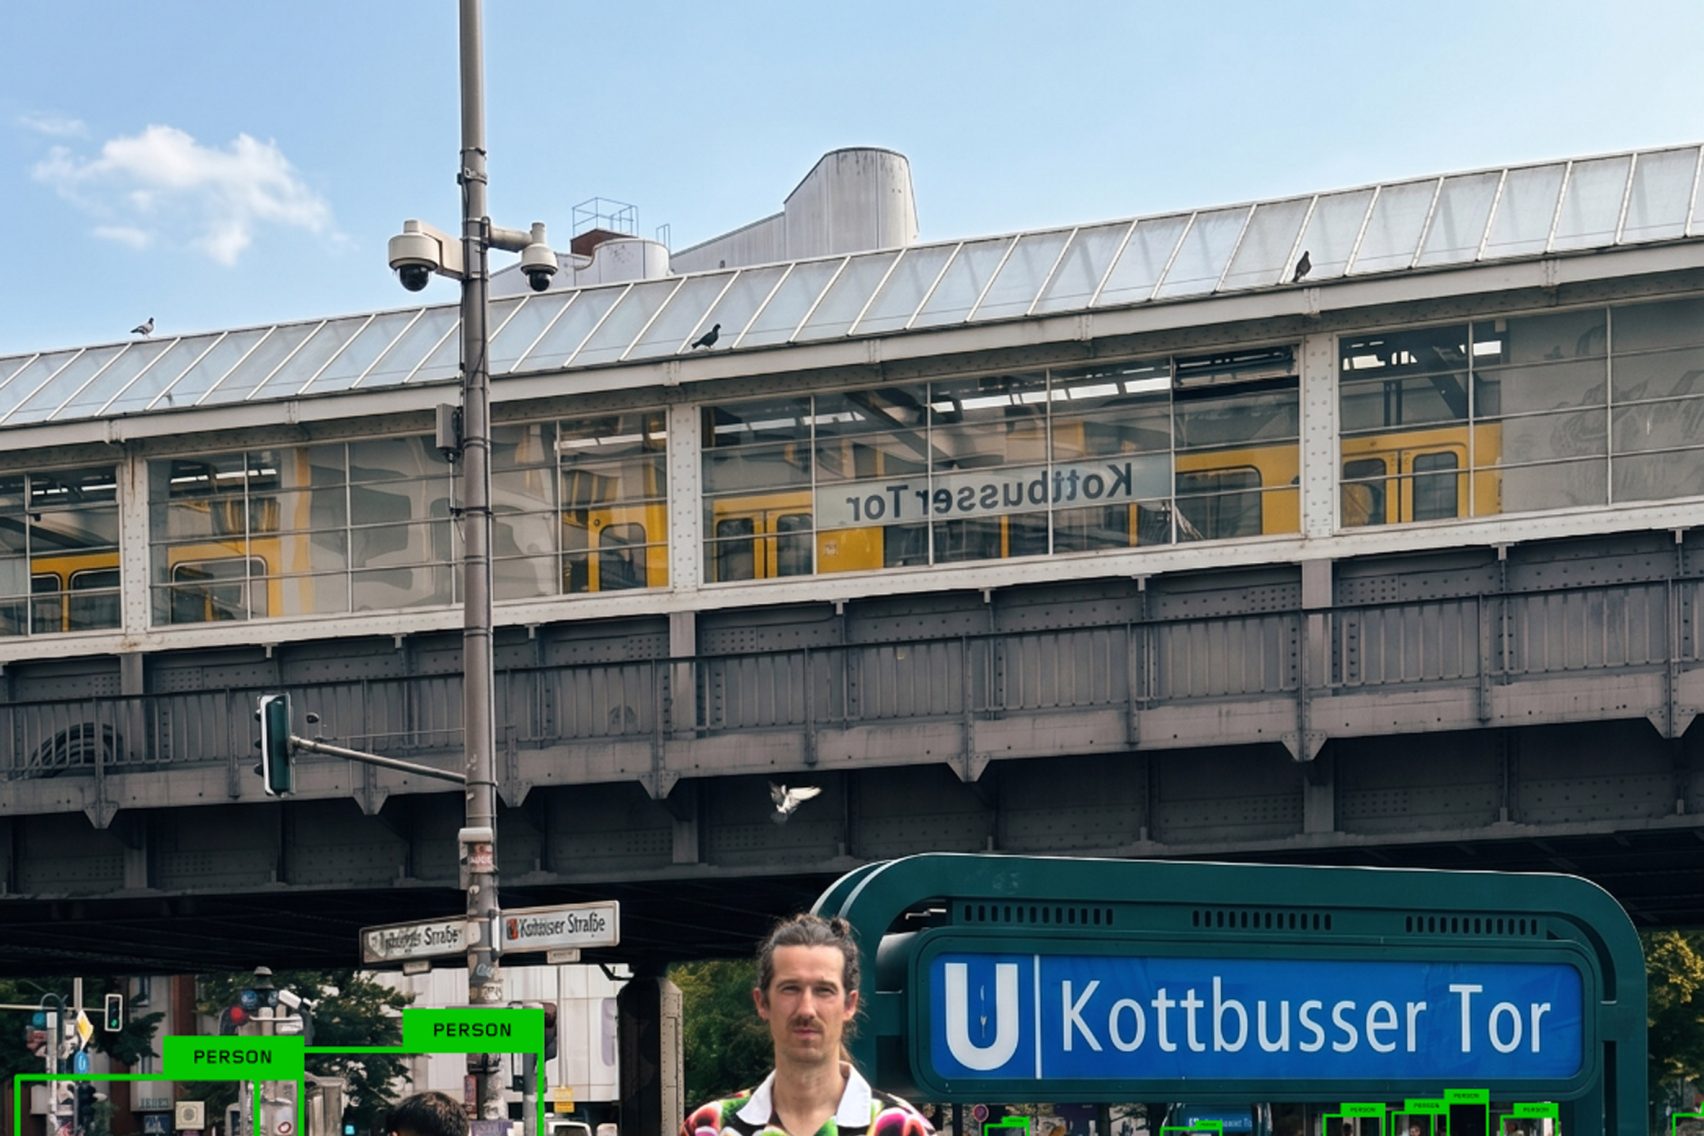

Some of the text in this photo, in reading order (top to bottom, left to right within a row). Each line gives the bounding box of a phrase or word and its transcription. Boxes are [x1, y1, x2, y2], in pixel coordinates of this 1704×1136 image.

[568, 912, 605, 935] Straße
[945, 963, 1551, 1071] U Kottbusser Tor
